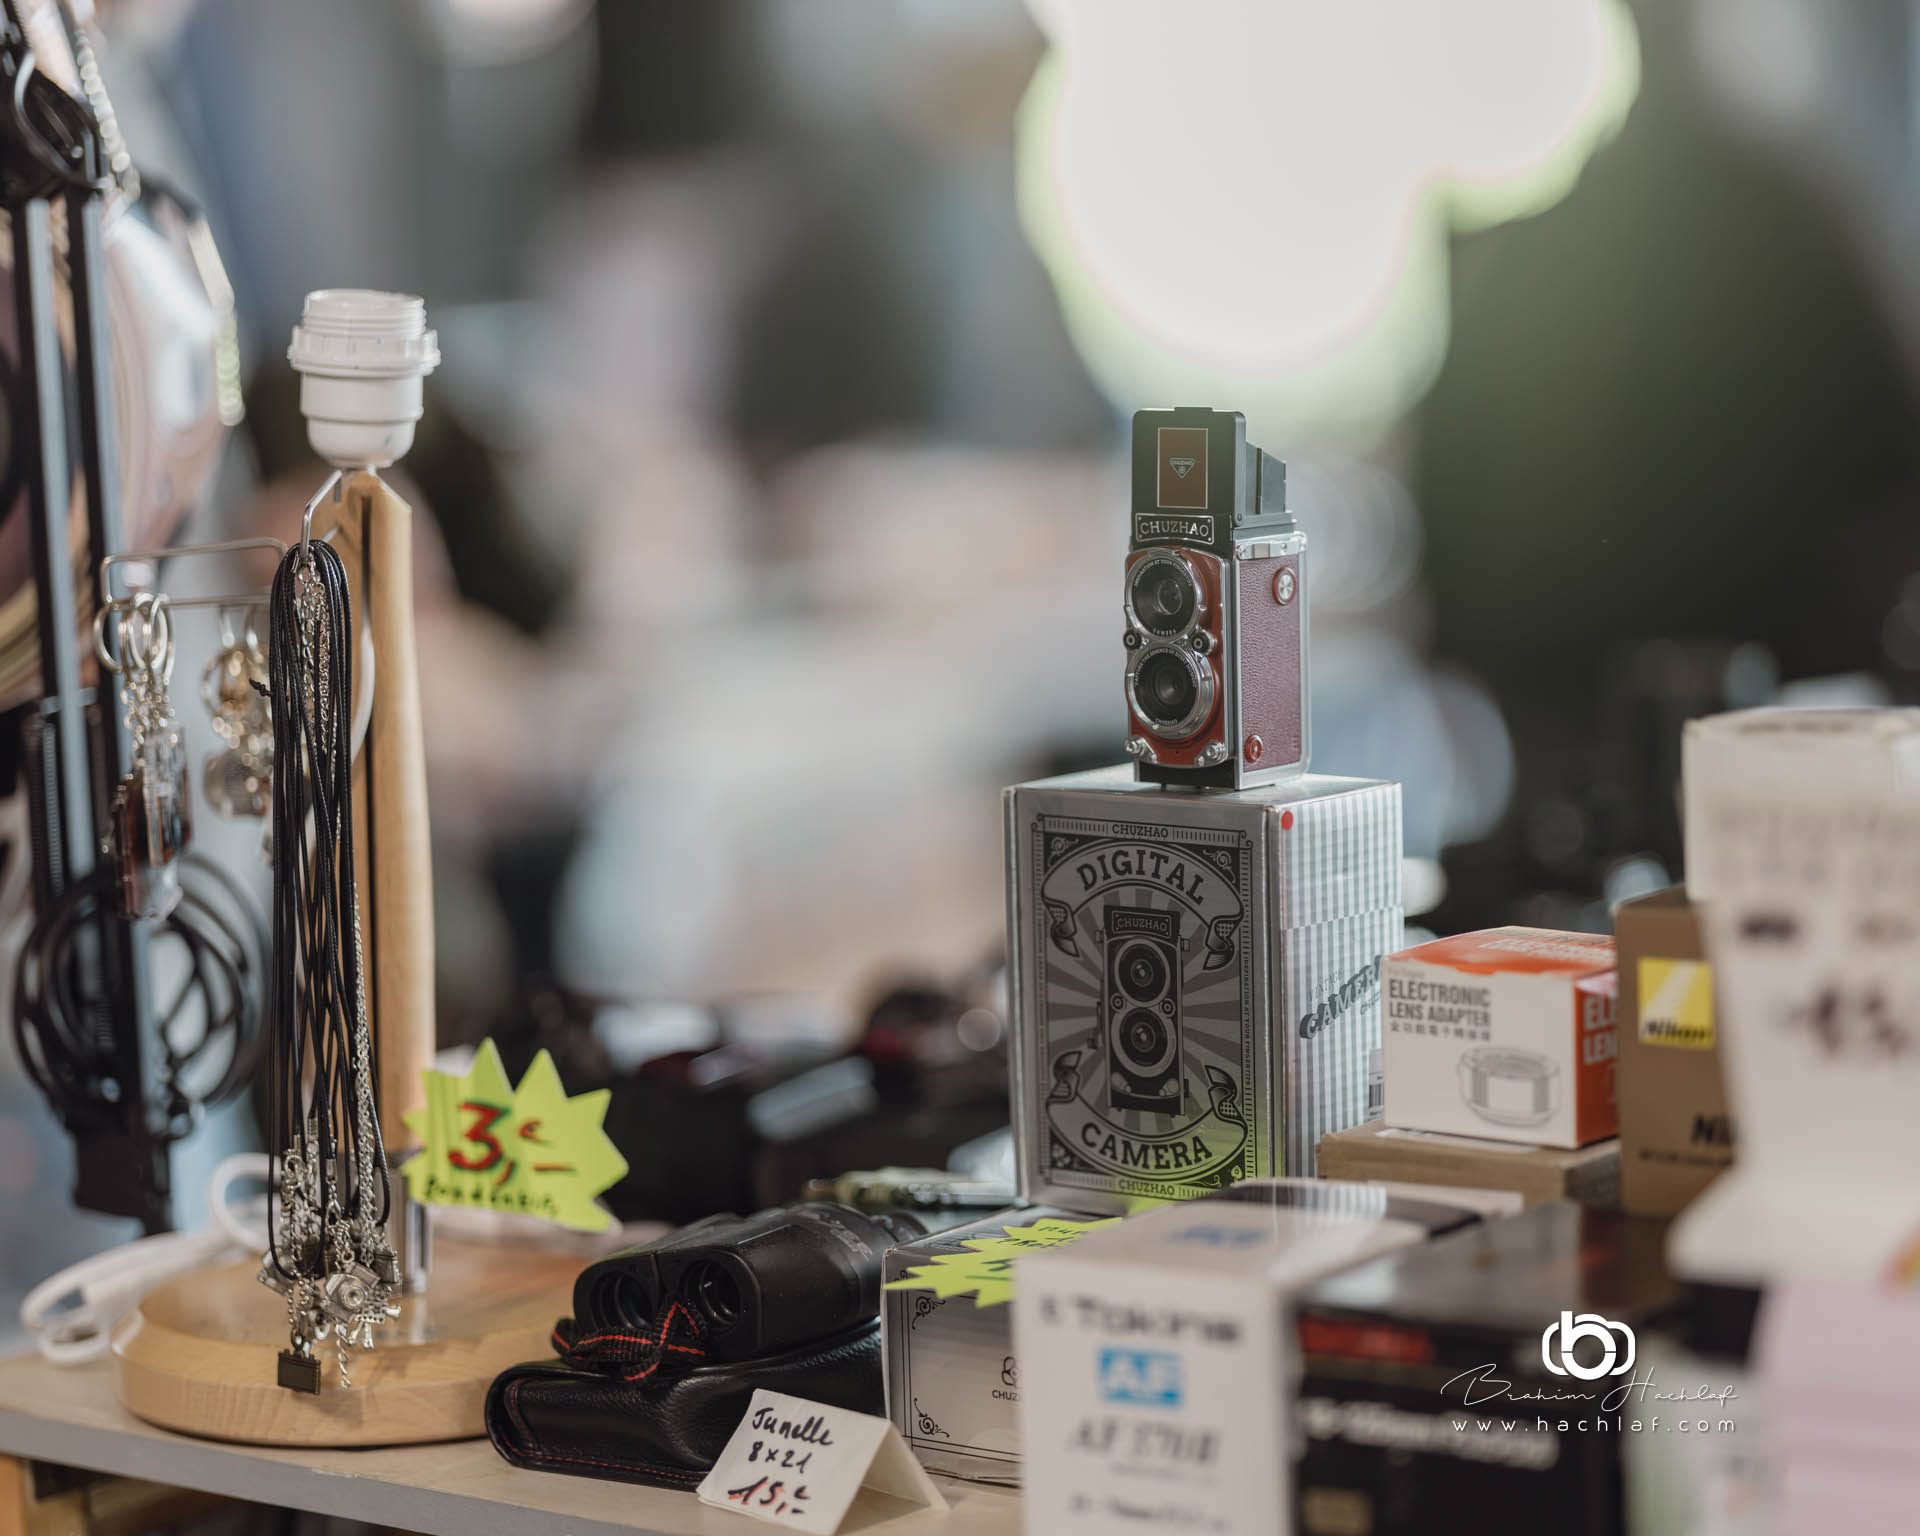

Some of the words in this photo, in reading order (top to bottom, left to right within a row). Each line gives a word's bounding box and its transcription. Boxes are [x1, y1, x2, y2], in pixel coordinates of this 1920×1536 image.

[1140, 520, 1209, 537] CHUZHAO
[1112, 824, 1169, 838] CHUZHAO
[1076, 849, 1206, 905] DIGITAL
[1117, 916, 1168, 933] CHUZHAO
[1389, 978, 1492, 1007] ELECTRONIC
[1389, 1002, 1424, 1021] LENS
[1427, 1006, 1491, 1028] ADAPTER
[1080, 1122, 1214, 1170] CAMERA
[1118, 1178, 1175, 1197] CHUZHAO
